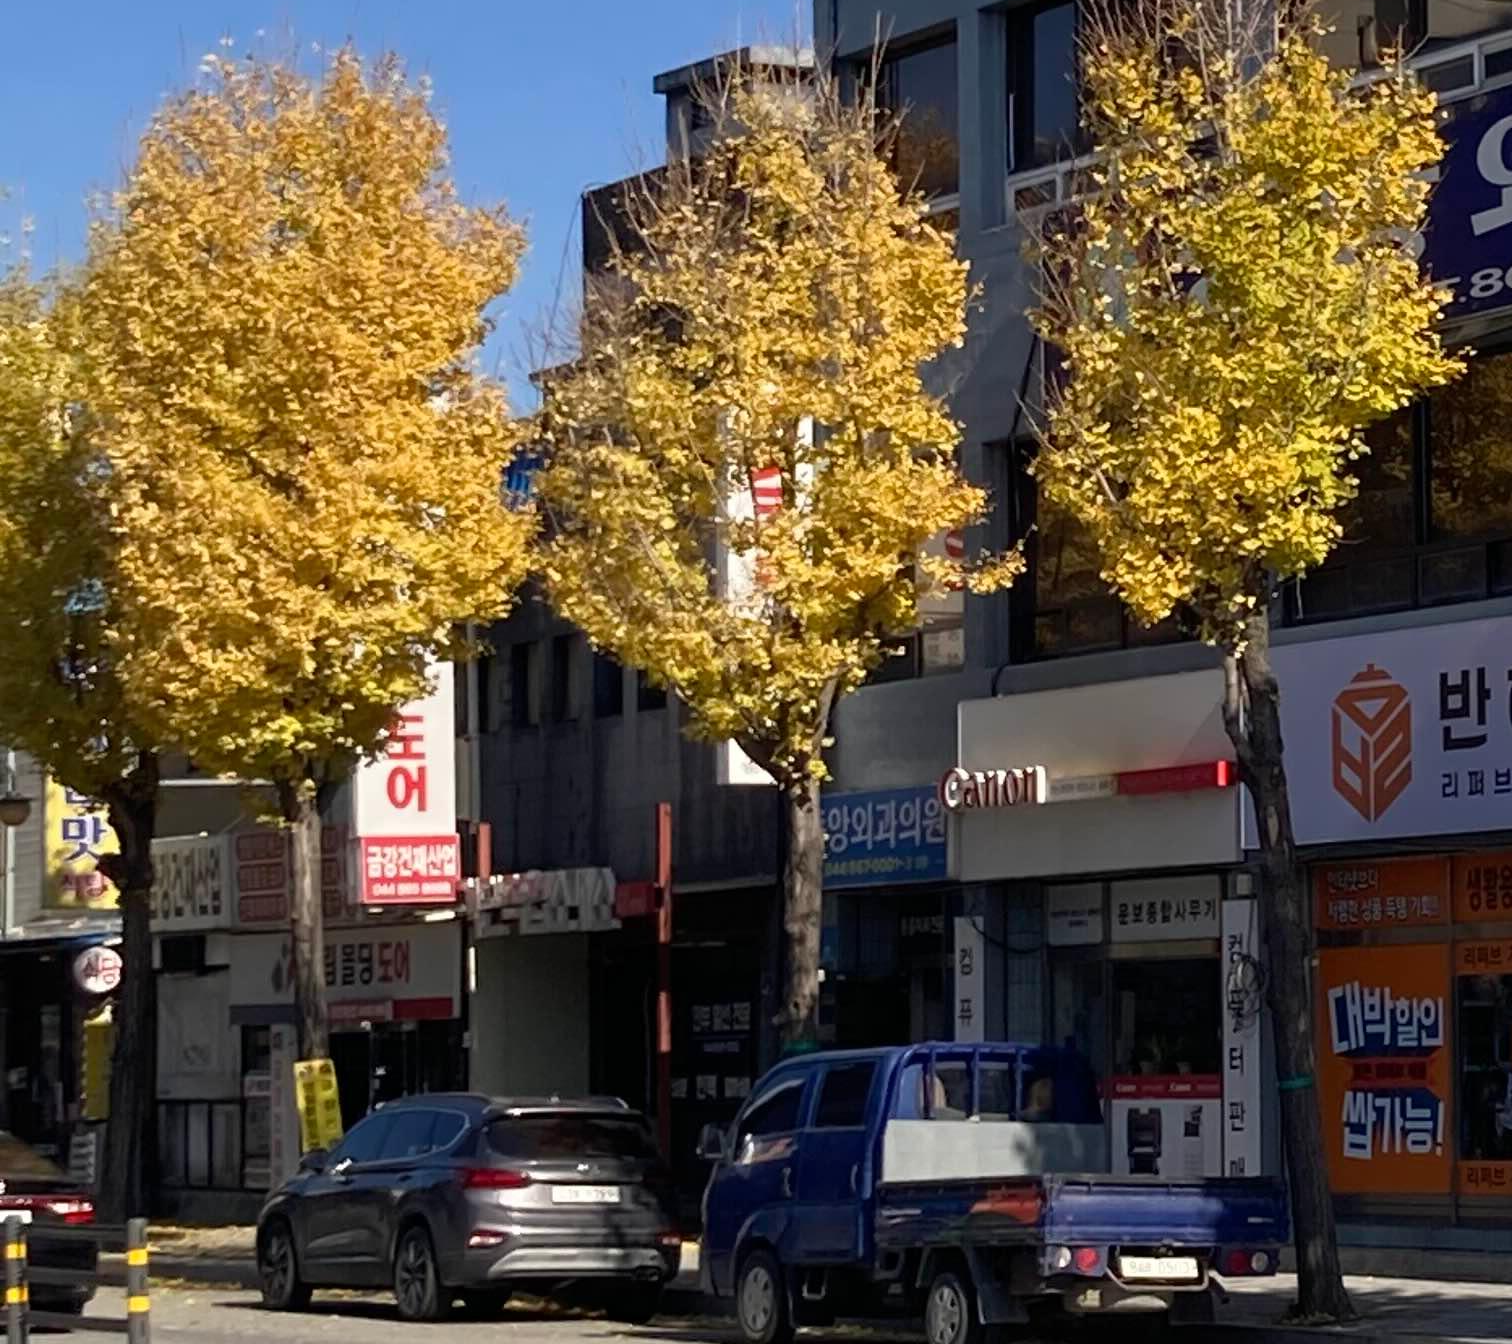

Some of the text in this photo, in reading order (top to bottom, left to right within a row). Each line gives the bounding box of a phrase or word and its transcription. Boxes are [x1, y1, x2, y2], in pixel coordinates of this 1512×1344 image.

[940, 765, 1047, 809] Canon
[1441, 767, 1512, 798] 리퍼브
[822, 797, 946, 854] 앙외과의원
[1326, 979, 1446, 1055] 대박할인
